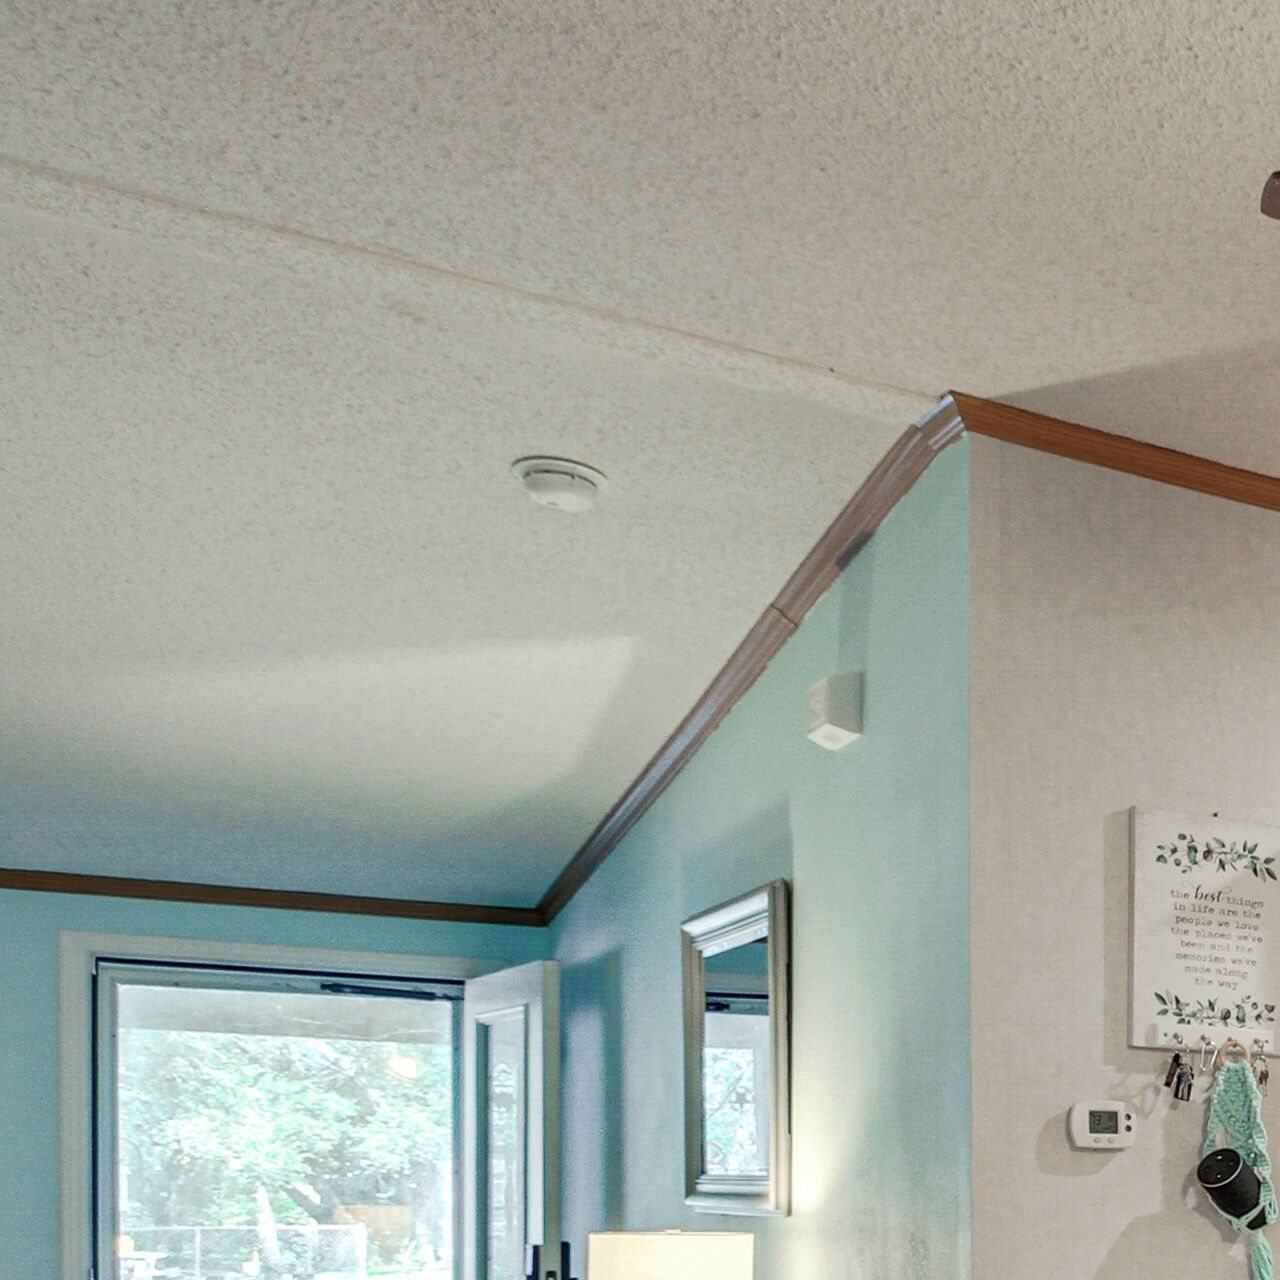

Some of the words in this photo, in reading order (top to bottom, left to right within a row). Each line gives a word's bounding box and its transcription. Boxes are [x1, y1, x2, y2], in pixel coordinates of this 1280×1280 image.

[1170, 889, 1190, 900] the
[1193, 884, 1223, 903] best
[1226, 896, 1264, 910] things
[1173, 903, 1186, 912] in
[1191, 903, 1215, 914] life
[1218, 908, 1239, 917] are
[1243, 910, 1262, 919] the
[1175, 916, 1213, 927] people
[1217, 920, 1230, 928] we
[1235, 920, 1260, 931] love
[1170, 927, 1190, 936] the
[1195, 929, 1232, 940] places
[1180, 940, 1205, 949] been
[1209, 943, 1231, 952] and
[1235, 945, 1254, 953] the
[1175, 953, 1226, 964] memories
[1215, 967, 1249, 980] along
[1194, 977, 1213, 986] the
[1217, 980, 1239, 991] way
